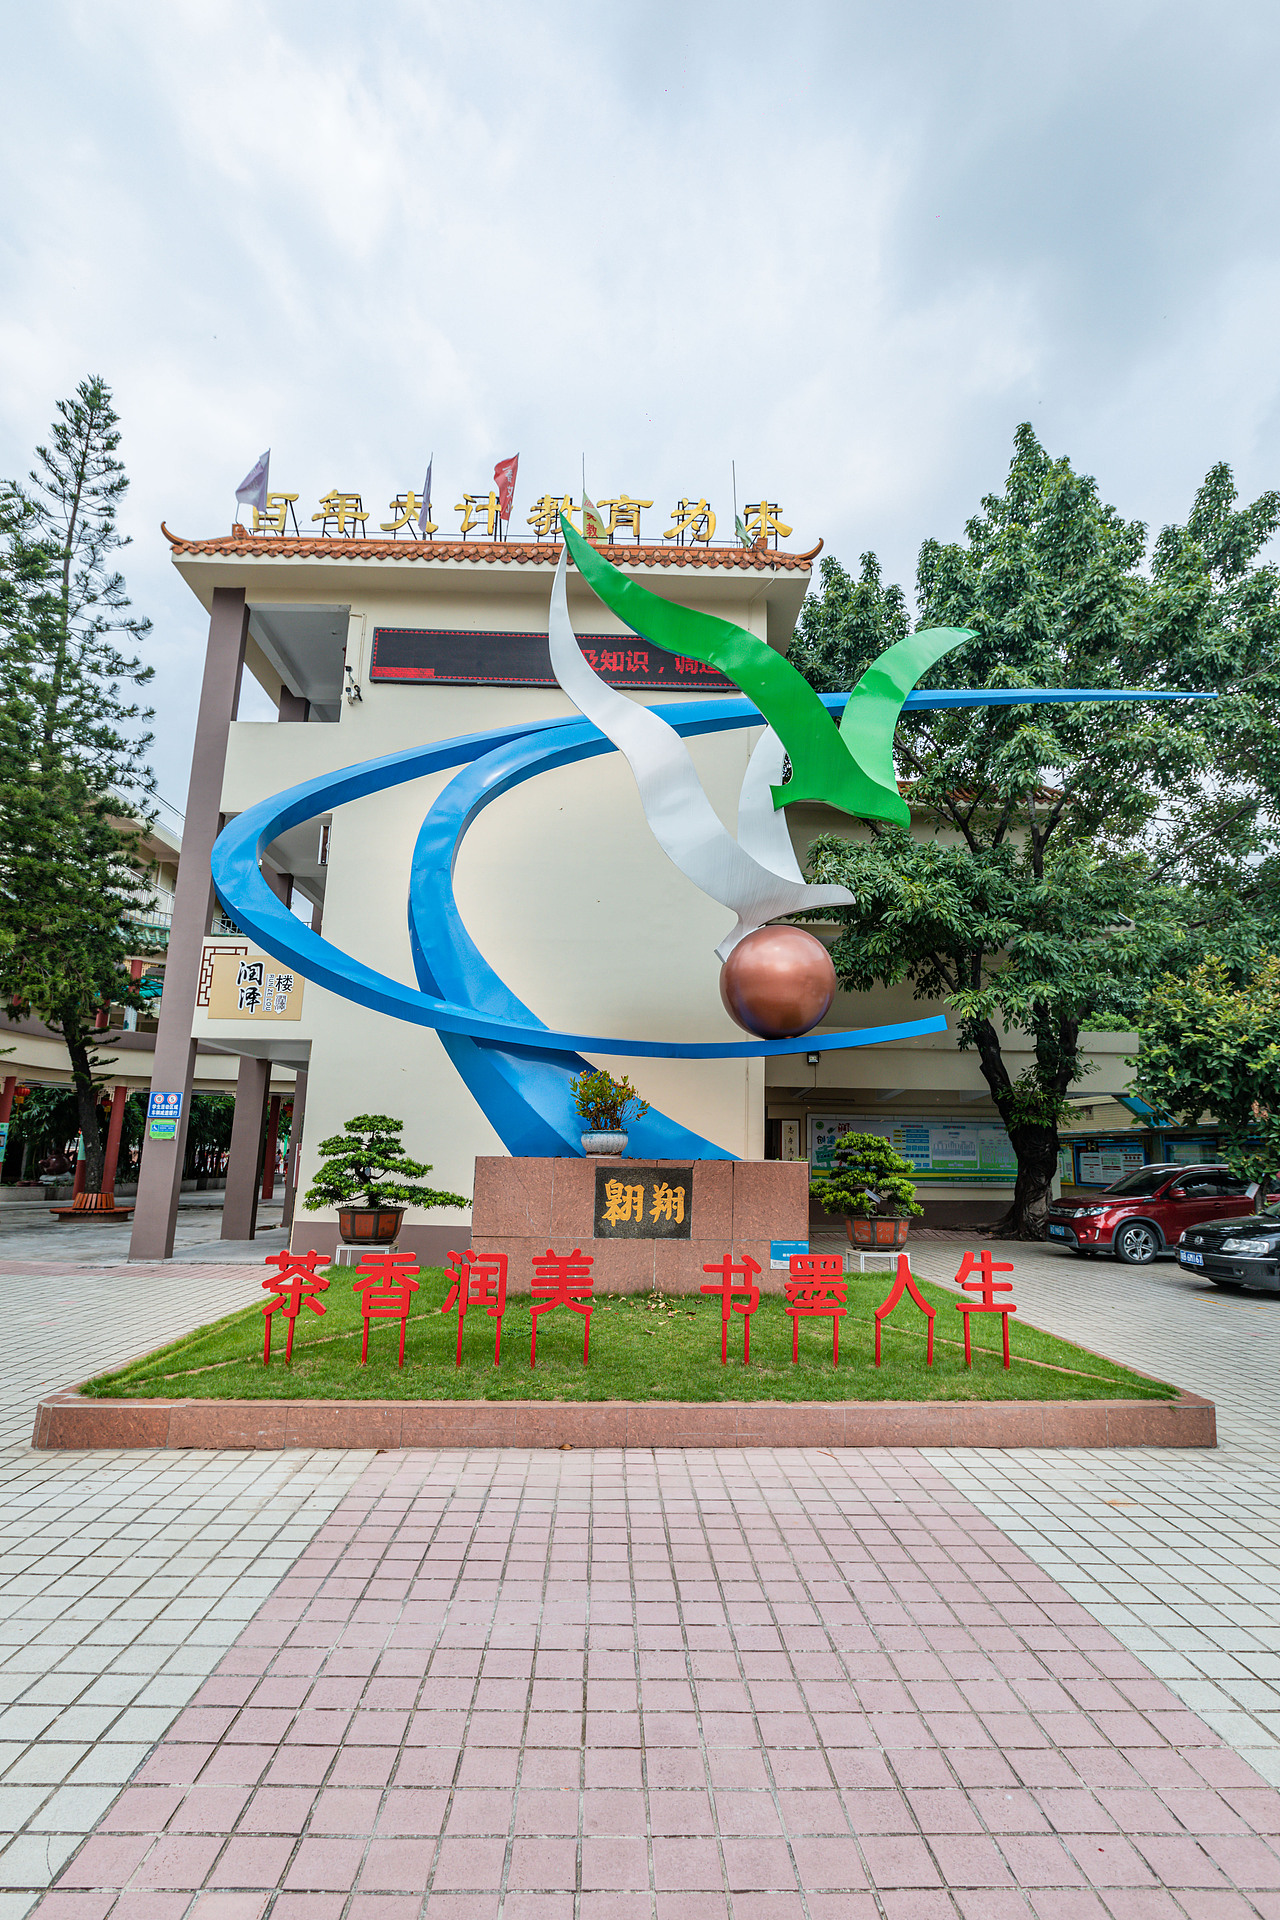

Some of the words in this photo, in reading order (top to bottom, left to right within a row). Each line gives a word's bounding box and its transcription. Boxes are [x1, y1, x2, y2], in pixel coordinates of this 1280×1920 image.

[252, 489, 793, 541] 百年大计教育为本
[275, 974, 293, 992] 楼
[601, 1178, 686, 1227] 翱翔
[262, 1249, 594, 1318] 茶香润美
[700, 1250, 1017, 1320] 书墨人生
